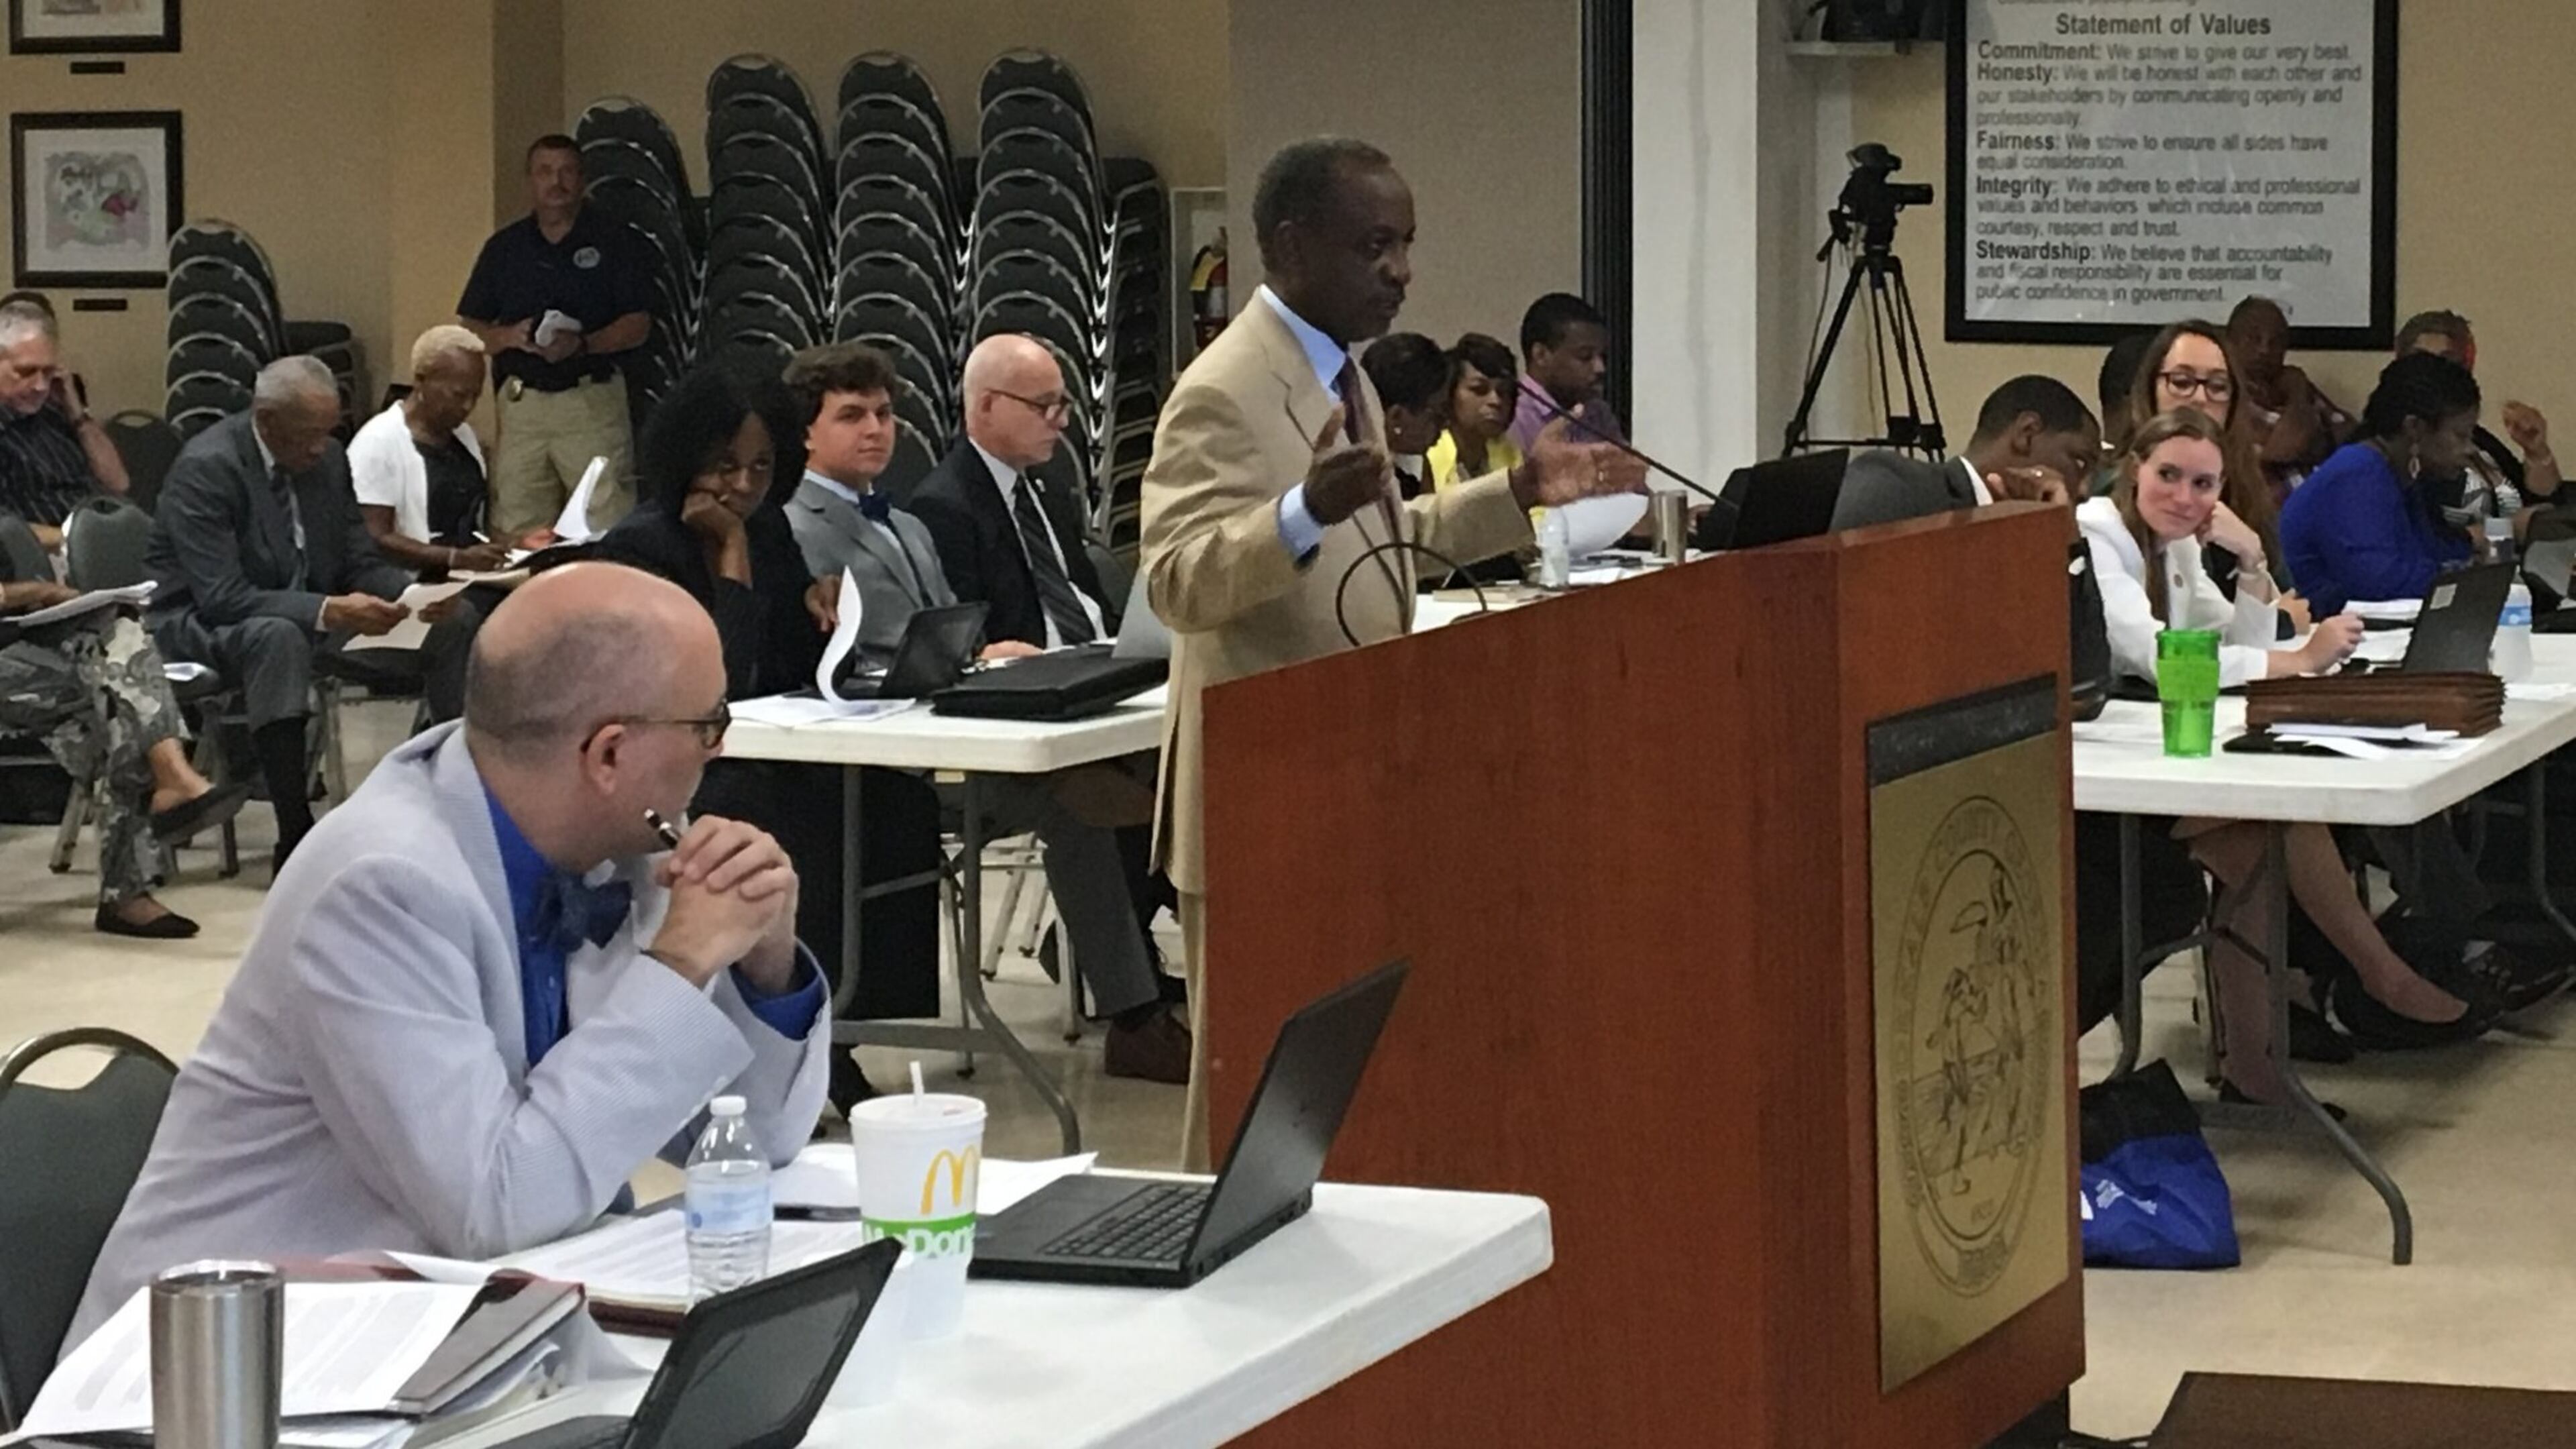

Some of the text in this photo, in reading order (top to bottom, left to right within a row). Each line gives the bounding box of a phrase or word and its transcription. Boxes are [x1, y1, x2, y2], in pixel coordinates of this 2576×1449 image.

[2056, 13, 2271, 34] Statement of Values
[1978, 40, 2100, 60] Commitment:
[2107, 44, 2132, 60] We
[2185, 45, 2198, 60] to
[2205, 46, 2236, 62] give
[2243, 48, 2268, 60] our
[2275, 47, 2308, 64] very
[2063, 65, 2088, 80] We
[2123, 65, 2141, 80] be
[2147, 65, 2198, 80] honest
[2242, 65, 2279, 80] each
[2284, 65, 2325, 80] other
[2332, 64, 2362, 81] and
[1977, 91, 2002, 103] our
[2109, 88, 2127, 107] by
[2255, 88, 2306, 105] openly
[2312, 87, 2343, 103] and
[2066, 134, 2090, 150] We
[2143, 135, 2157, 150] to
[2163, 137, 2216, 150] ensure
[2222, 134, 2239, 150] all
[2290, 134, 2328, 151] have
[2067, 178, 2091, 193] We
[2096, 178, 2150, 193] adhere
[2156, 178, 2171, 193] to
[2176, 178, 2226, 194] ethical
[2231, 178, 2260, 194] and
[2265, 178, 2360, 197] professional
[1977, 199, 2025, 213] values
[2031, 198, 2059, 213] and
[2148, 199, 2192, 213] which
[2257, 201, 2323, 214] common
[2047, 221, 2103, 237] respect
[2110, 221, 2138, 235] and
[1976, 240, 2332, 265] Stewardship: We believe that accountability
[1976, 264, 2004, 278] and
[2158, 268, 2182, 280] are
[2187, 266, 2256, 280] essential
[2261, 265, 2283, 280] for
[2114, 285, 2126, 299] in
